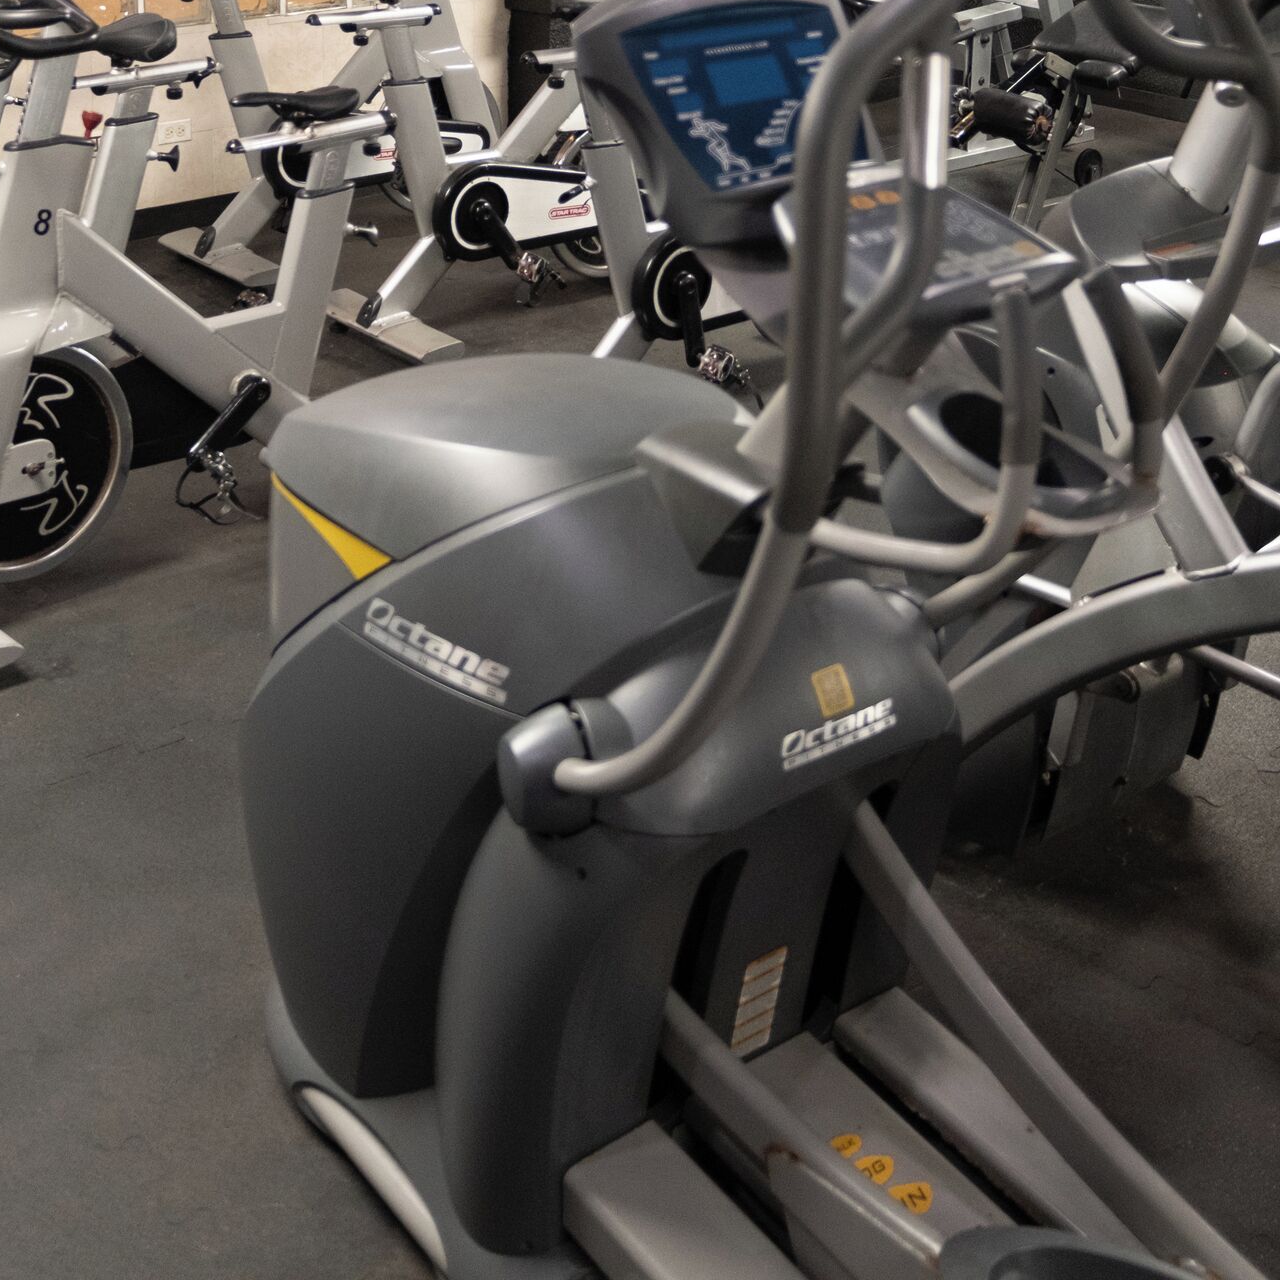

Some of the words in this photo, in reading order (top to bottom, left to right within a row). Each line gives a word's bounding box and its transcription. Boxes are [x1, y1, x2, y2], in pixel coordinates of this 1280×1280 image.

[34, 208, 52, 236] 8
[551, 209, 569, 218] STAR
[366, 597, 511, 686] Octane
[781, 697, 893, 759] Octane
